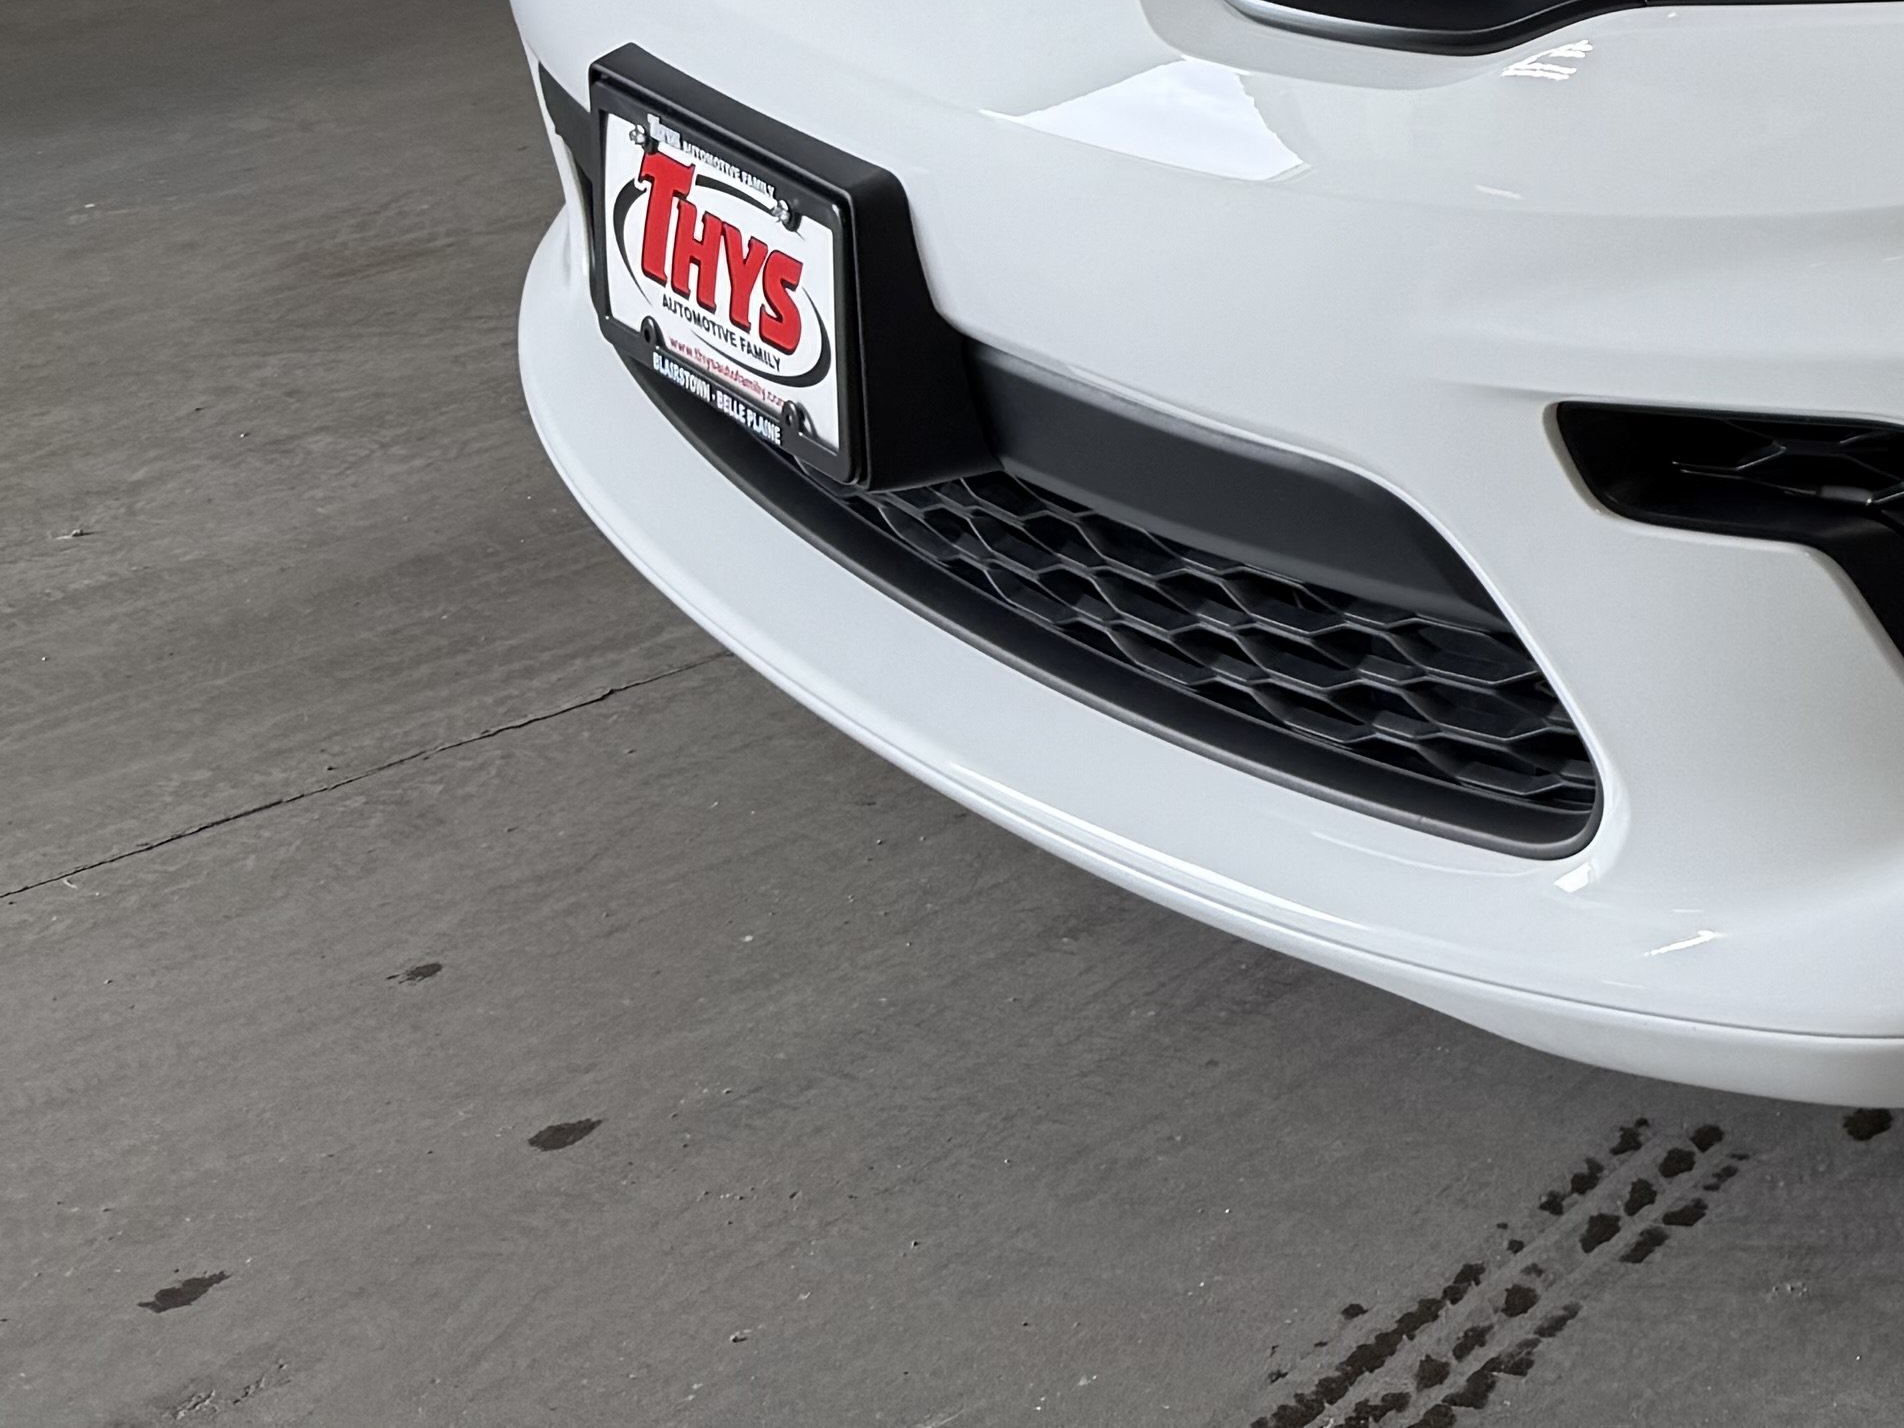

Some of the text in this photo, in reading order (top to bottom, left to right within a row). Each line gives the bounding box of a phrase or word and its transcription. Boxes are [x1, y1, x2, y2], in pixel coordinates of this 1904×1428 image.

[741, 170, 776, 199] FAMILY
[640, 149, 803, 356] THYS
[662, 294, 781, 373] AUTOMOTIVE FAMILY
[652, 351, 782, 445] BLAIRSTOWN BELLE PLAINE
